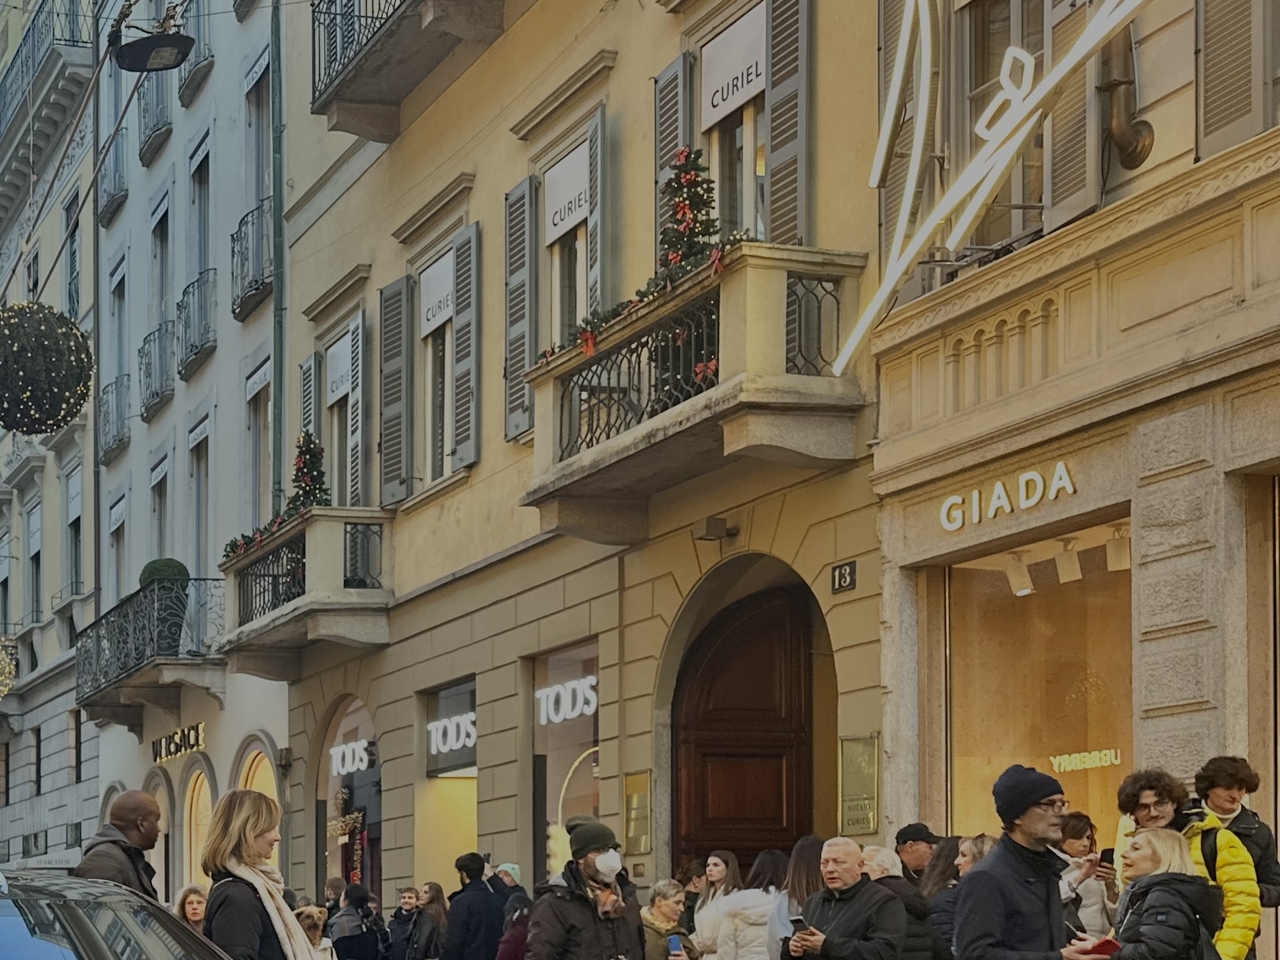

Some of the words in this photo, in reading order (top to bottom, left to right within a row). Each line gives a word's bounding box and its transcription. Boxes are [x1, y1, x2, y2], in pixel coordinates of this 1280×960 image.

[711, 60, 762, 109] CURIEL
[552, 188, 588, 227] CURIEL
[940, 461, 1075, 532] GIADA
[834, 565, 851, 590] 13
[152, 722, 205, 763] VERSACE
